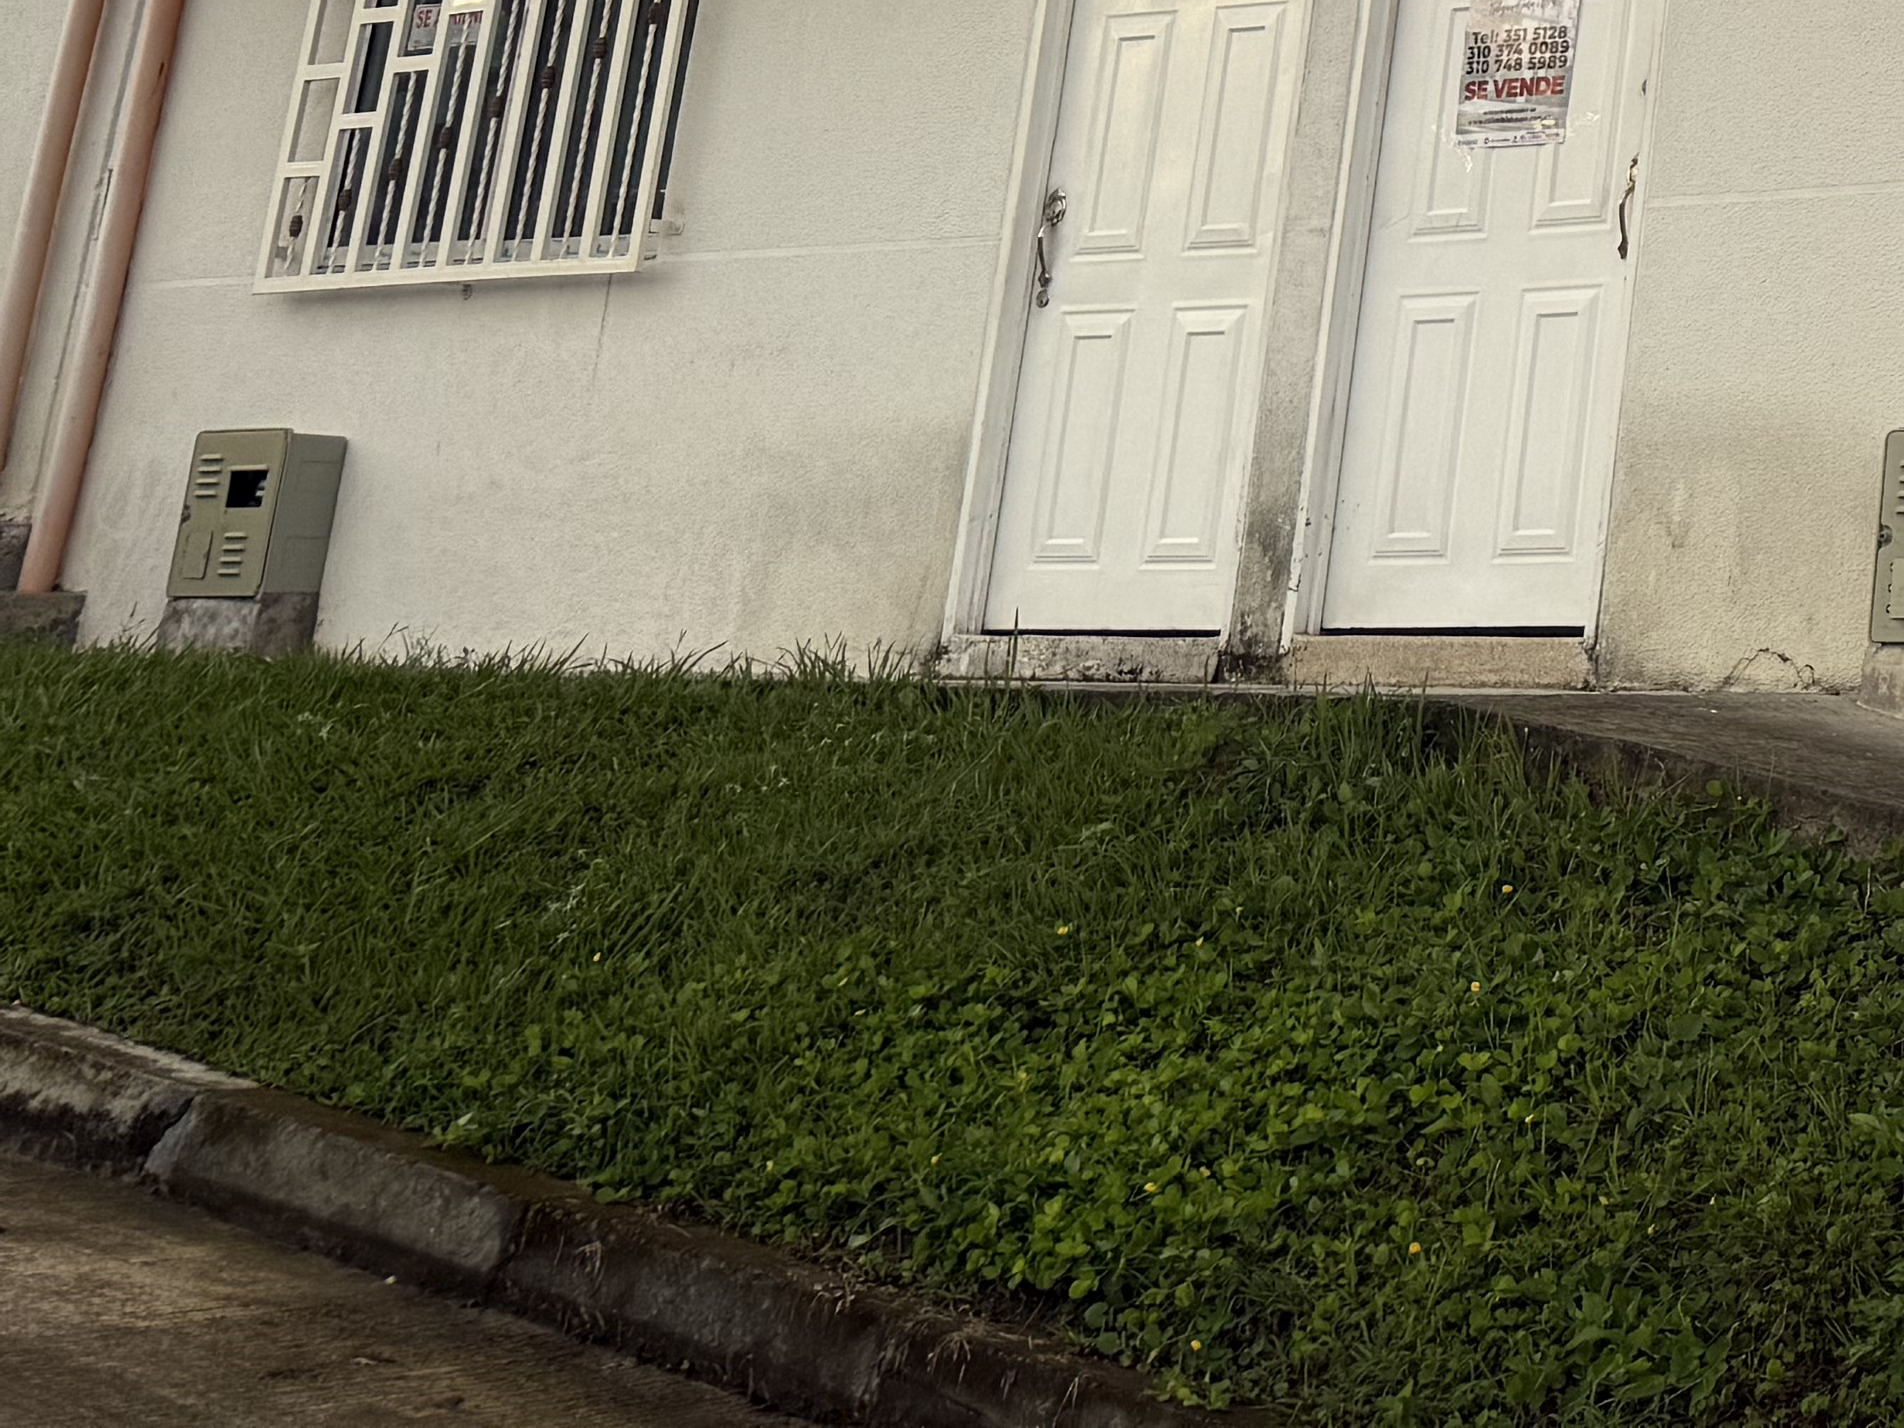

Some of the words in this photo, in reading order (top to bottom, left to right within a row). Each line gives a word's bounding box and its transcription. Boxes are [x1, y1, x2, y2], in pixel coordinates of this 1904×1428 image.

[416, 9, 432, 29] SE
[1472, 30, 1499, 45] Tel:
[1503, 28, 1528, 43] 351
[1532, 25, 1568, 41] 5128
[1467, 45, 1491, 60] 310
[1495, 43, 1523, 58] 374
[1528, 40, 1570, 55] 0089
[1466, 60, 1490, 75] 310
[1494, 57, 1523, 73] 748
[1527, 55, 1568, 70] 5989
[1464, 80, 1489, 101] SE
[1493, 75, 1566, 99] VENDE
